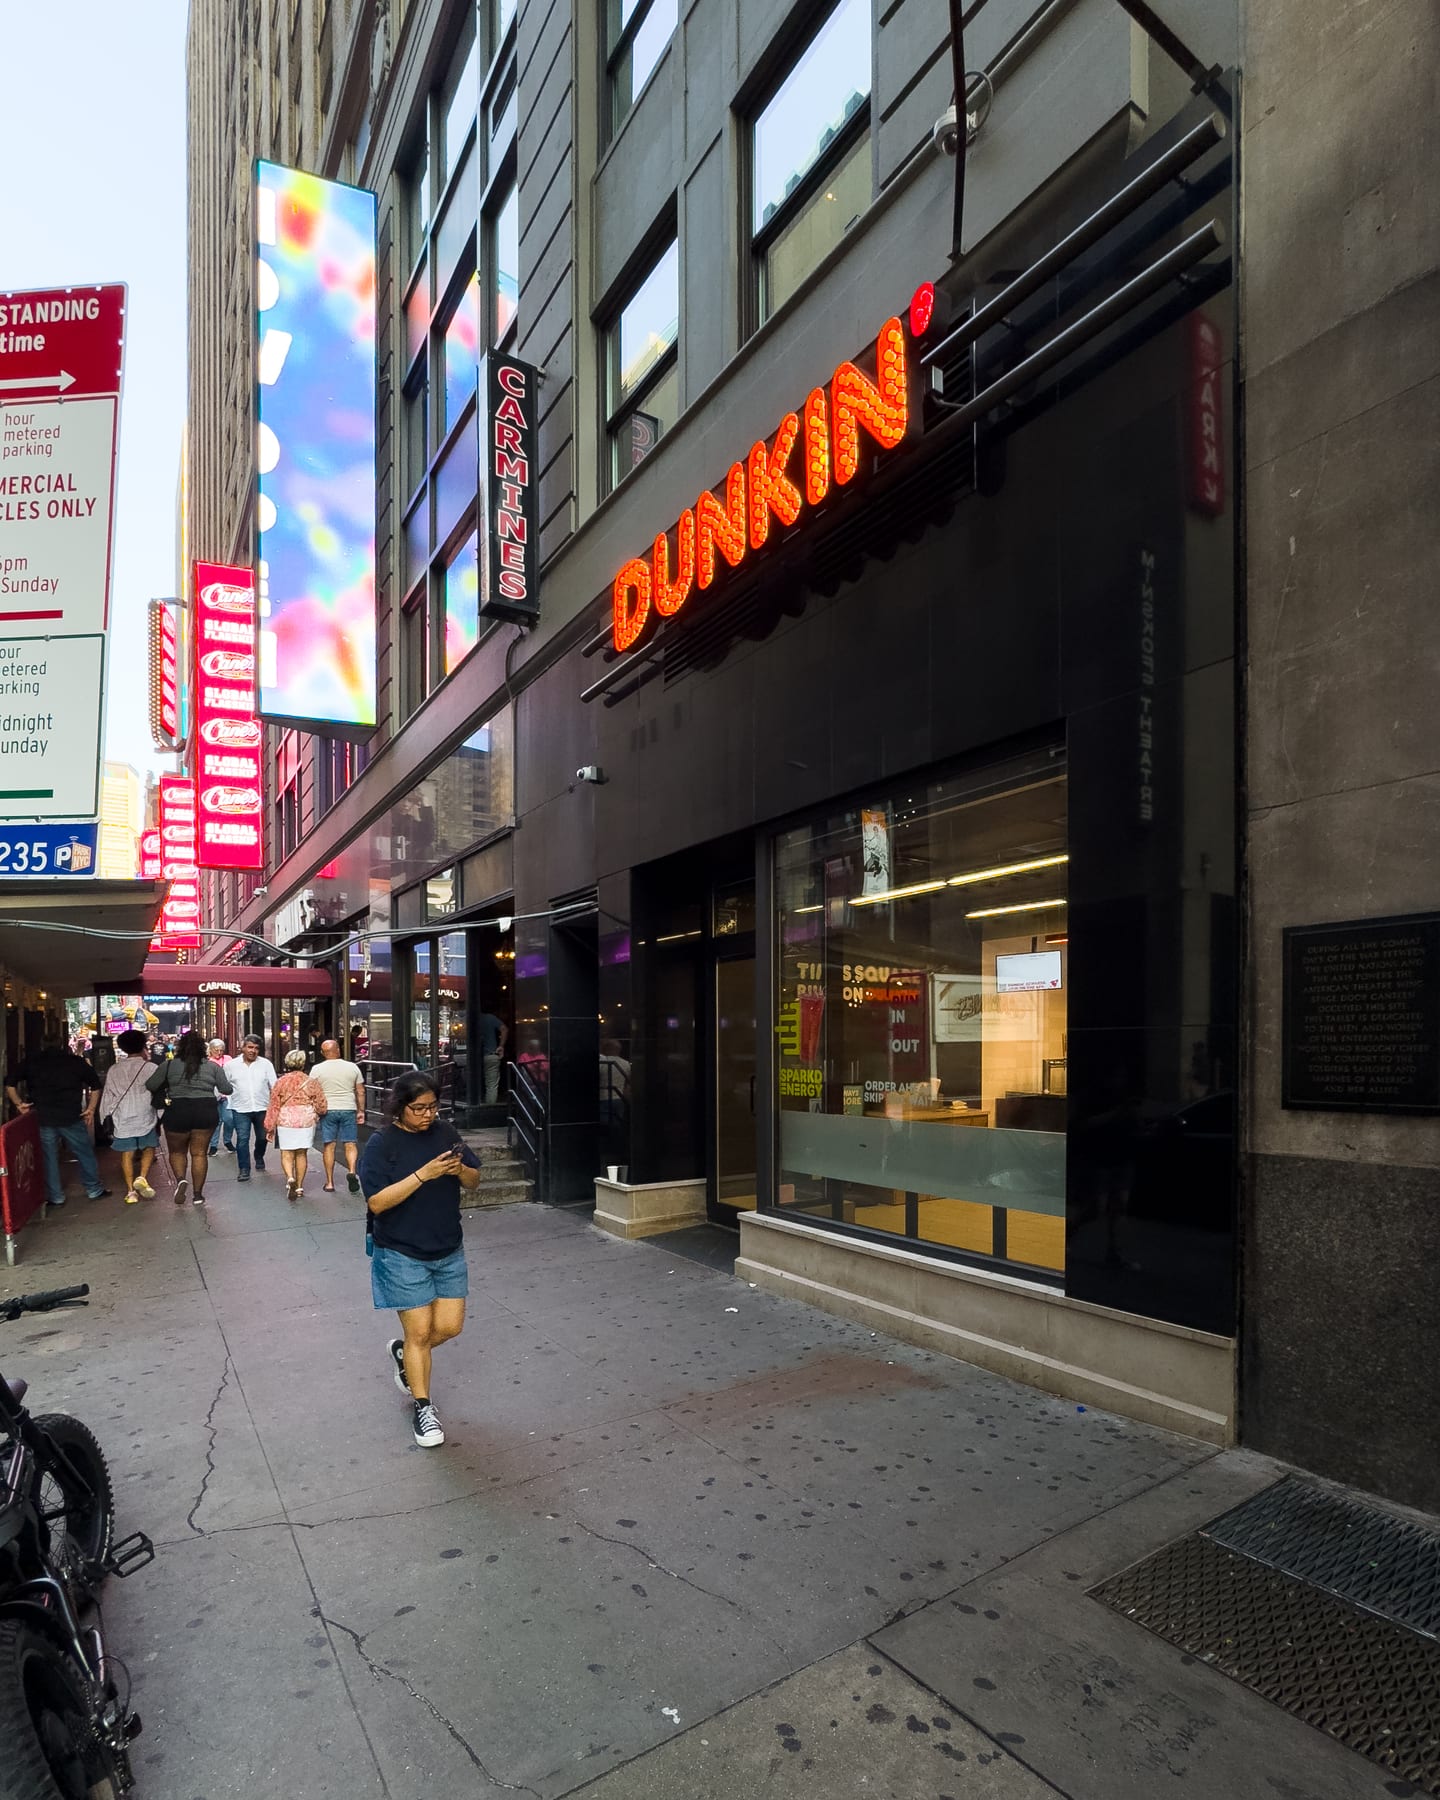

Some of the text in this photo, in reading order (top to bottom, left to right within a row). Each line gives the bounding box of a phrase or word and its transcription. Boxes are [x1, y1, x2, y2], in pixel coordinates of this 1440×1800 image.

[0, 298, 100, 326] STANDING
[0, 331, 45, 354] time
[5, 413, 35, 426] hour
[4, 425, 61, 441] metered
[3, 442, 52, 459] parking
[495, 366, 528, 600] CARMINES
[0, 498, 97, 521] LES ONLY
[1, 576, 59, 595] Sunday
[0, 842, 48, 872] 235
[198, 983, 242, 994] CARMINES
[891, 1038, 920, 1053] OUT
[779, 1068, 823, 1084] SPARKD
[780, 1083, 823, 1097] ENERGY
[864, 1080, 896, 1092] ORDER
[863, 1092, 884, 1104] SKIP
